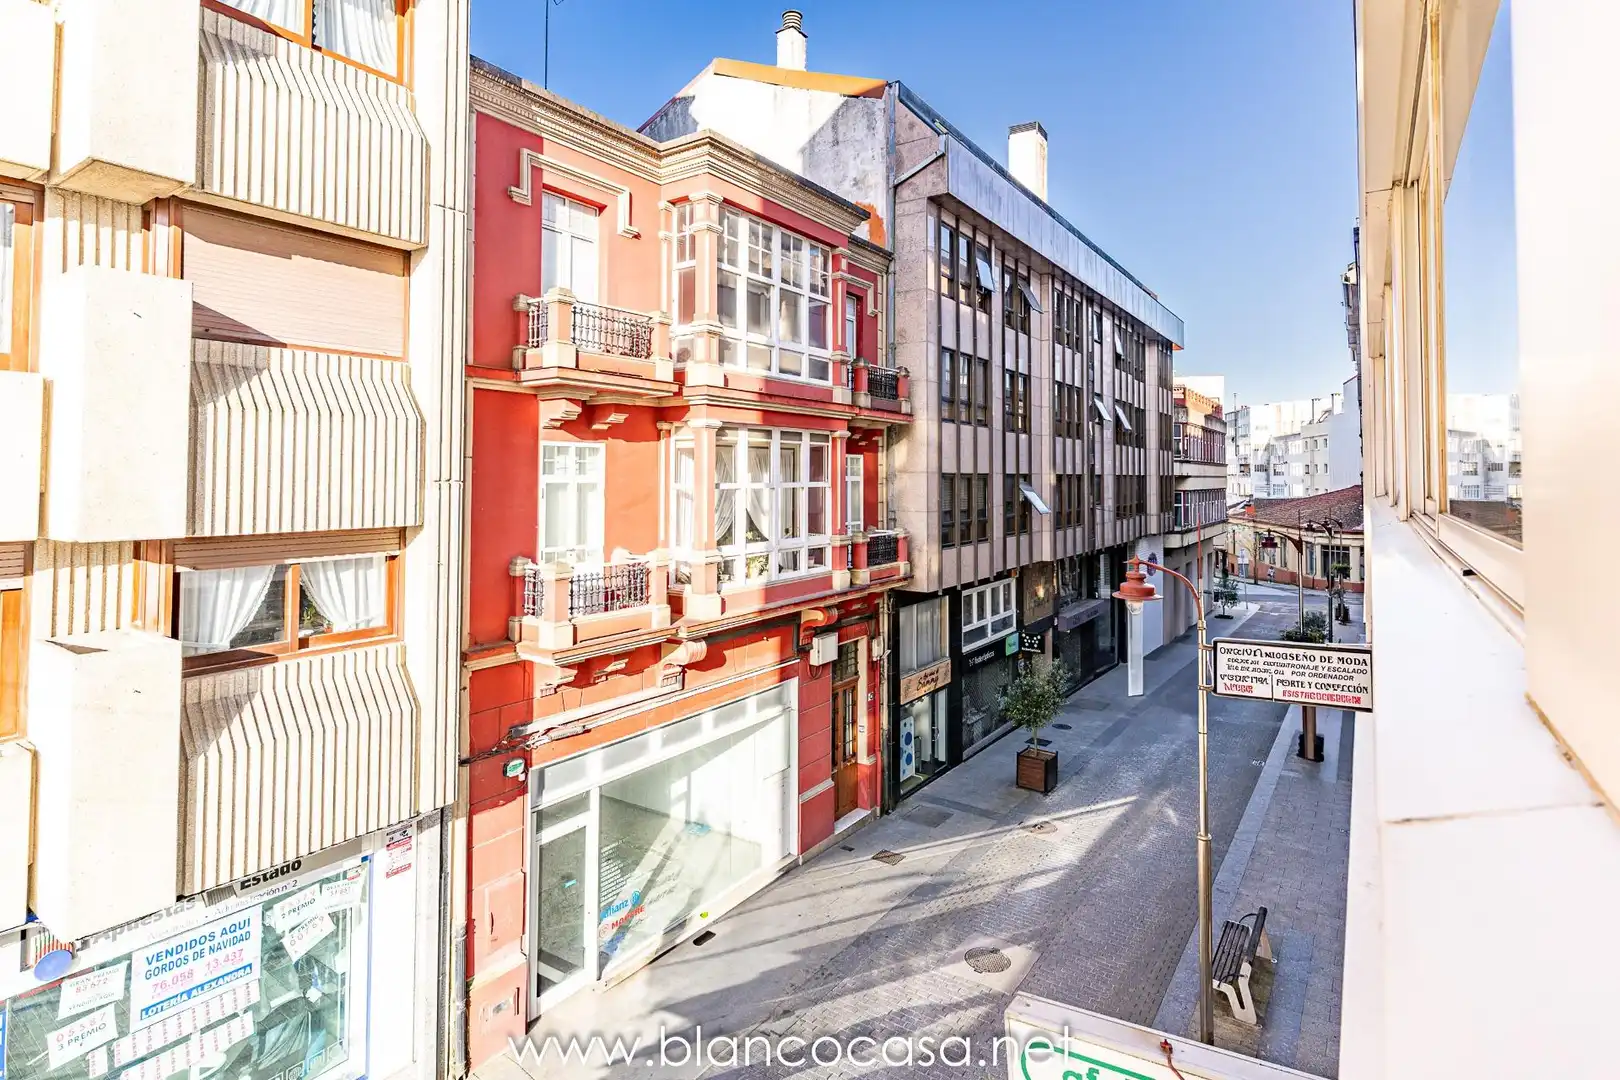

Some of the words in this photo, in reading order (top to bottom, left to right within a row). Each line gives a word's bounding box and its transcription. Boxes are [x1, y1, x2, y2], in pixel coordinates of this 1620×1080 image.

[1319, 655, 1334, 664] DE
[1337, 656, 1369, 667] MODA
[1291, 670, 1307, 678] POR
[1308, 672, 1354, 681] ORDENADOR
[1327, 665, 1368, 675] ESCALADO
[1307, 681, 1313, 689] Y
[240, 860, 302, 890] Estado
[292, 879, 298, 888] 2
[287, 897, 316, 916] PREMIO
[144, 954, 190, 980] GORDOS
[192, 948, 205, 962] DE
[208, 930, 251, 956] NAVIDAD
[145, 931, 216, 966] VENDIDOS
[67, 1022, 107, 1046] PREMIO
